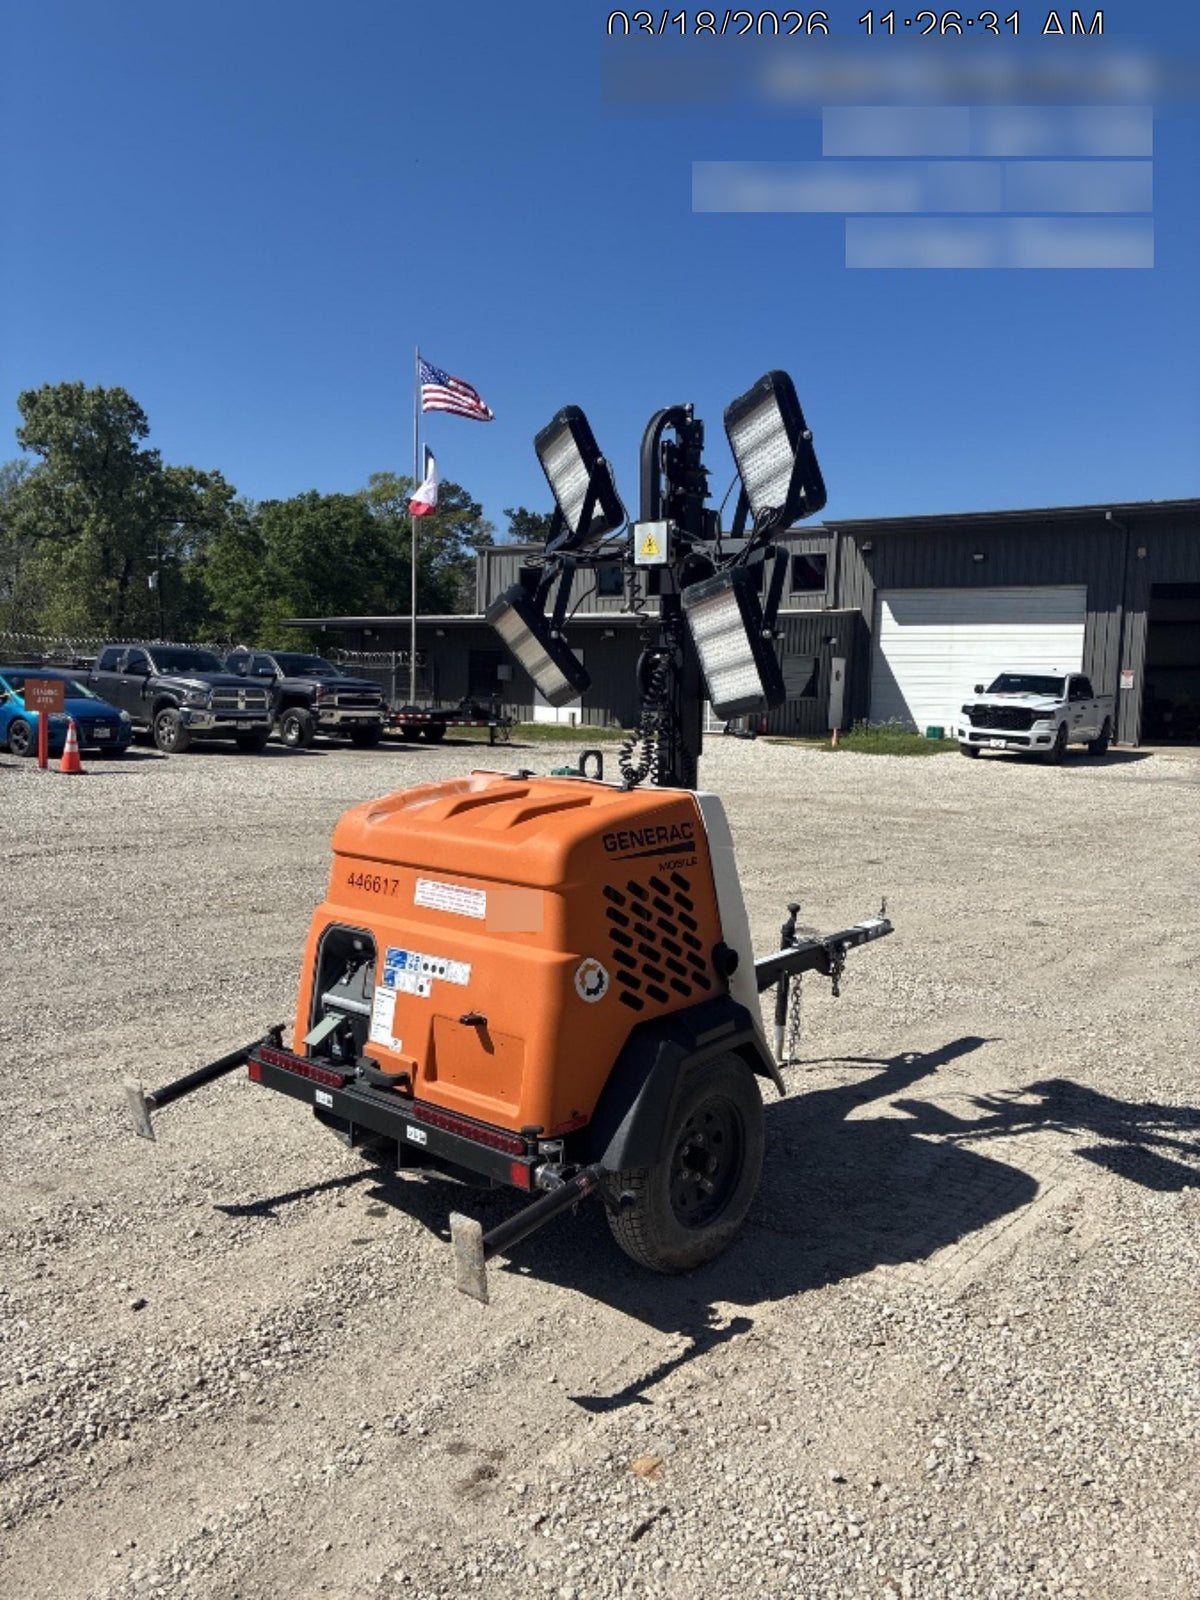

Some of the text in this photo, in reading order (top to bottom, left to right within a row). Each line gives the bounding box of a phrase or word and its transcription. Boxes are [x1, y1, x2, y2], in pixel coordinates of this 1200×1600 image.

[602, 822, 695, 852] GENERAC
[658, 856, 698, 872] MOBILE
[347, 871, 400, 898] 446617
